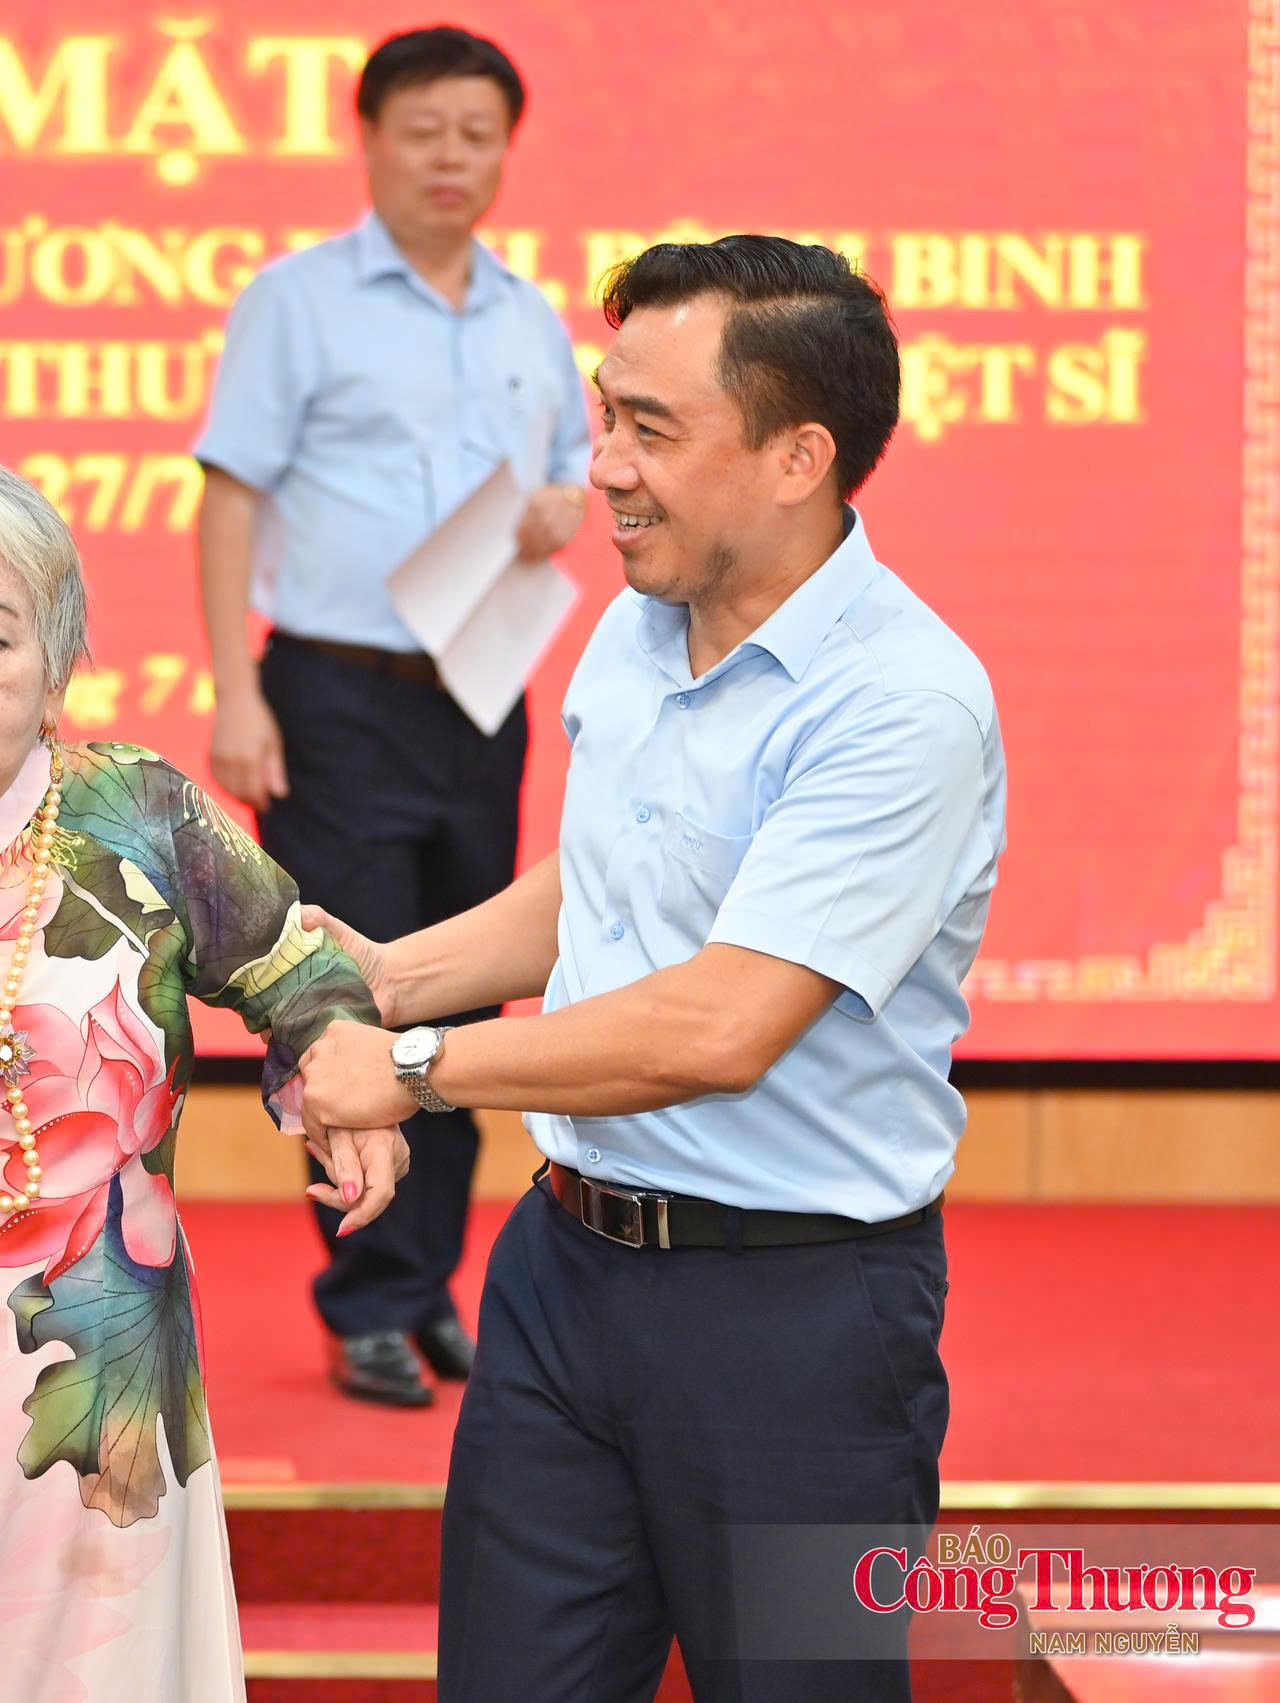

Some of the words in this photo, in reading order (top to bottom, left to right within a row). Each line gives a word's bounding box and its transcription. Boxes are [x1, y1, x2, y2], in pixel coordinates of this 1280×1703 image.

[889, 230, 1145, 309] BINH
[899, 331, 1036, 443] ỆT
[1046, 327, 1145, 426] SĨ
[142, 654, 187, 716] 7
